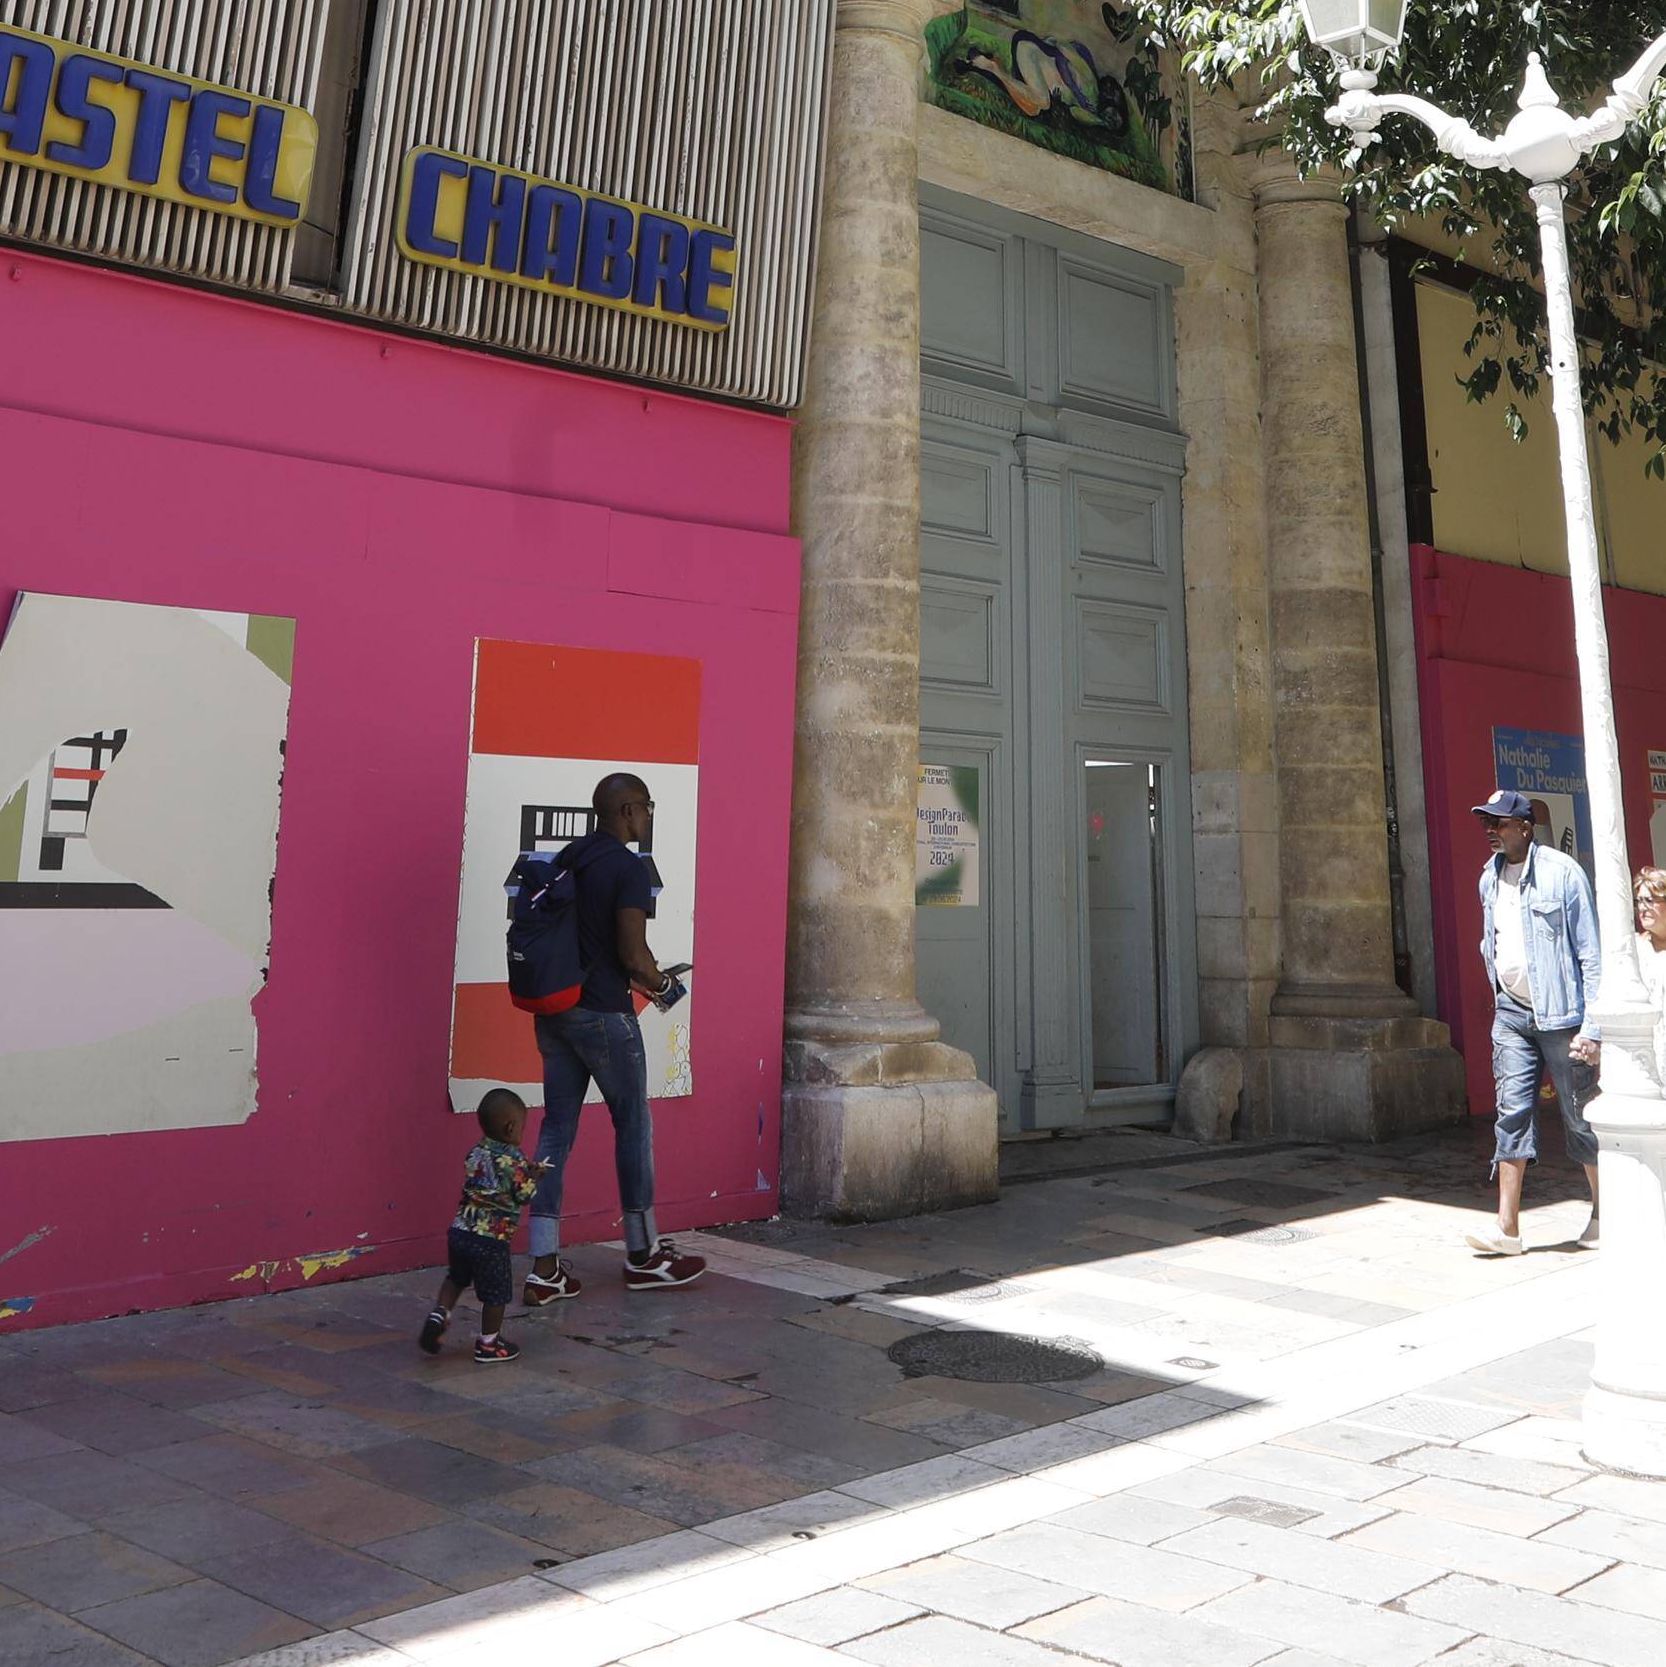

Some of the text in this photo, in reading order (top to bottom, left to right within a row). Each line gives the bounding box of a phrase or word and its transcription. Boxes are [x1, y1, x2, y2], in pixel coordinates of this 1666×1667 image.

[405, 145, 735, 326] CHABRE
[1498, 743, 1551, 769] Nathalie
[1516, 768, 1587, 794] Du Pasquier
[928, 820, 959, 836] Toulon
[929, 850, 956, 866] 2024
